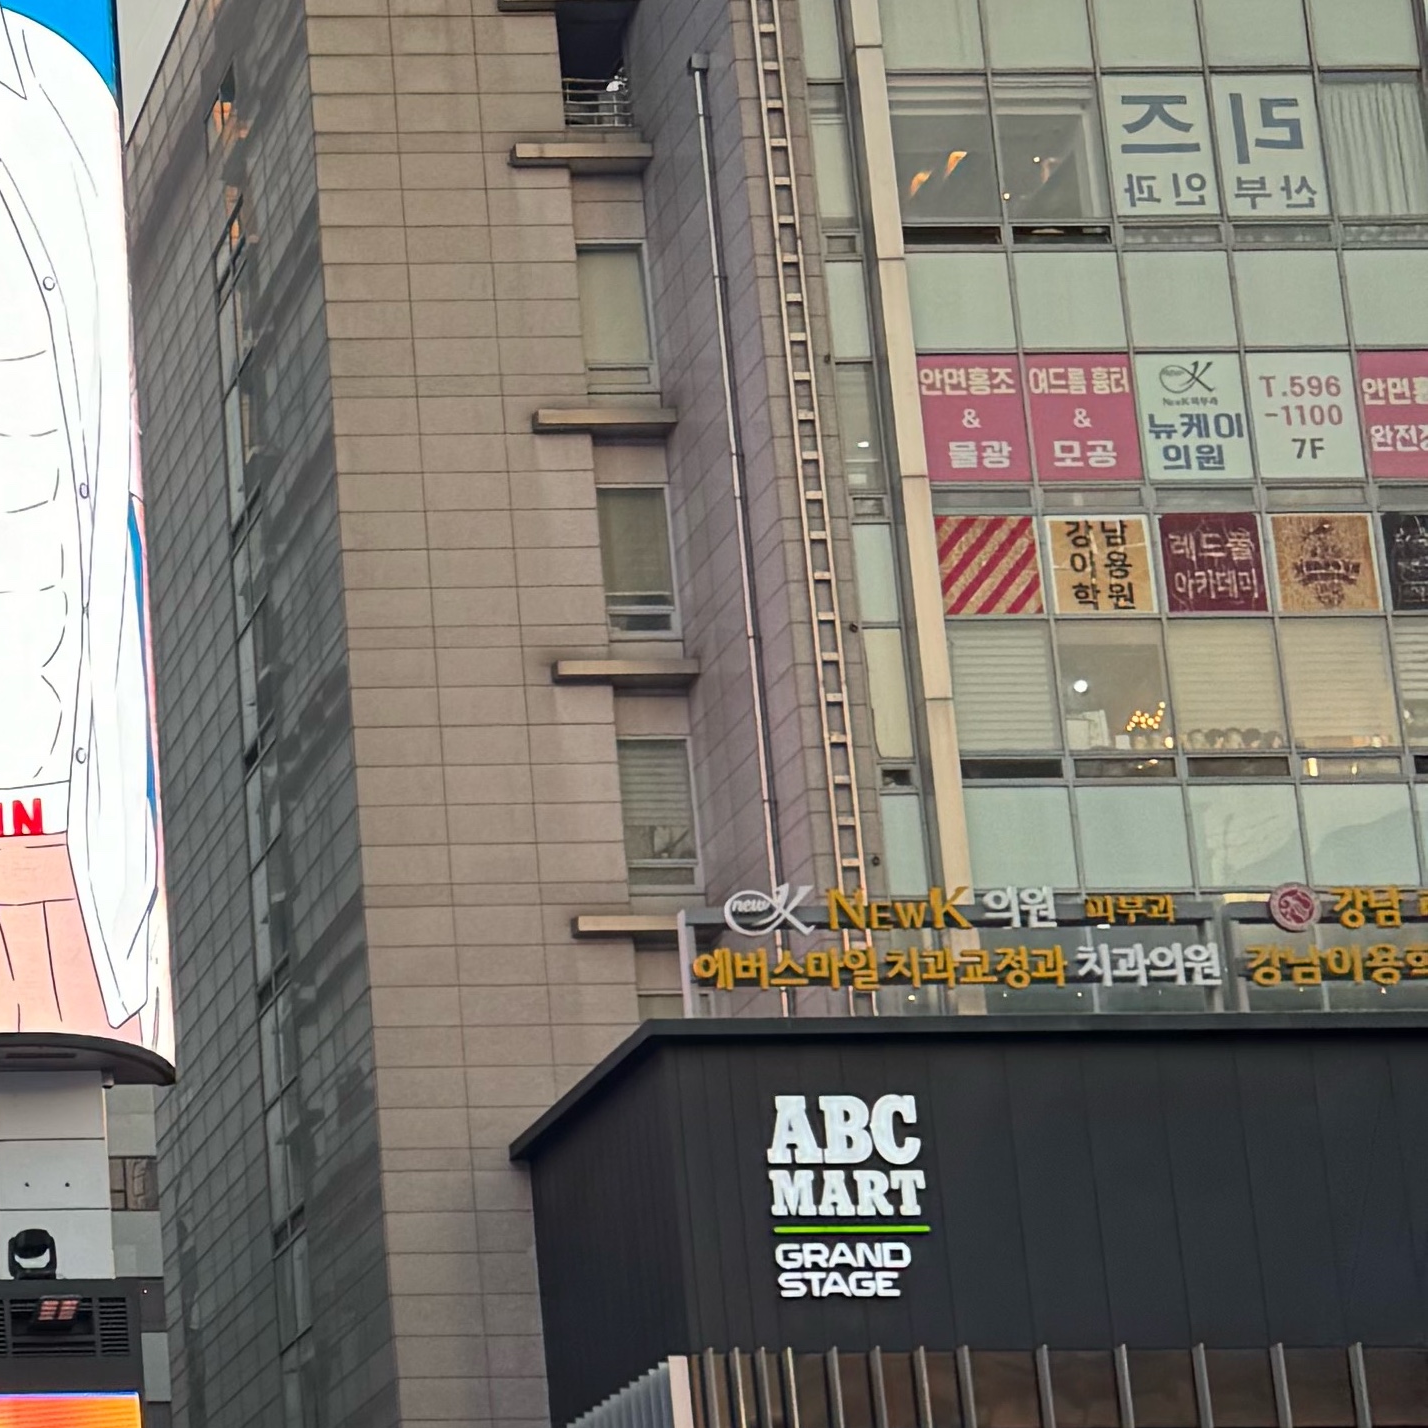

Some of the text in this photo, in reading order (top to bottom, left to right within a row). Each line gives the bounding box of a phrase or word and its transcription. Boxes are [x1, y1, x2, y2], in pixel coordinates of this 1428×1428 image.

[919, 367, 1016, 396] 안면홍조
[1029, 367, 1087, 394] 여드름
[1258, 375, 1342, 398] T.596
[962, 408, 981, 429] &
[1073, 408, 1092, 429] &
[1148, 412, 1244, 439] 뉴케이
[1264, 403, 1343, 427] -1100
[949, 440, 1012, 469] 물광
[1053, 440, 1117, 468] 모공
[1163, 444, 1226, 471] 의원
[1291, 437, 1324, 460] 7F
[982, 886, 1057, 928] 의원
[1085, 894, 1176, 925] 피부과
[1328, 884, 1403, 929] 강남
[692, 942, 1223, 991] 에버스마일 치과교정과 치과의원
[766, 1093, 922, 1165] ABC
[768, 1169, 927, 1217] MART
[774, 1242, 912, 1269] GRAND
[777, 1271, 901, 1298] STAGE
